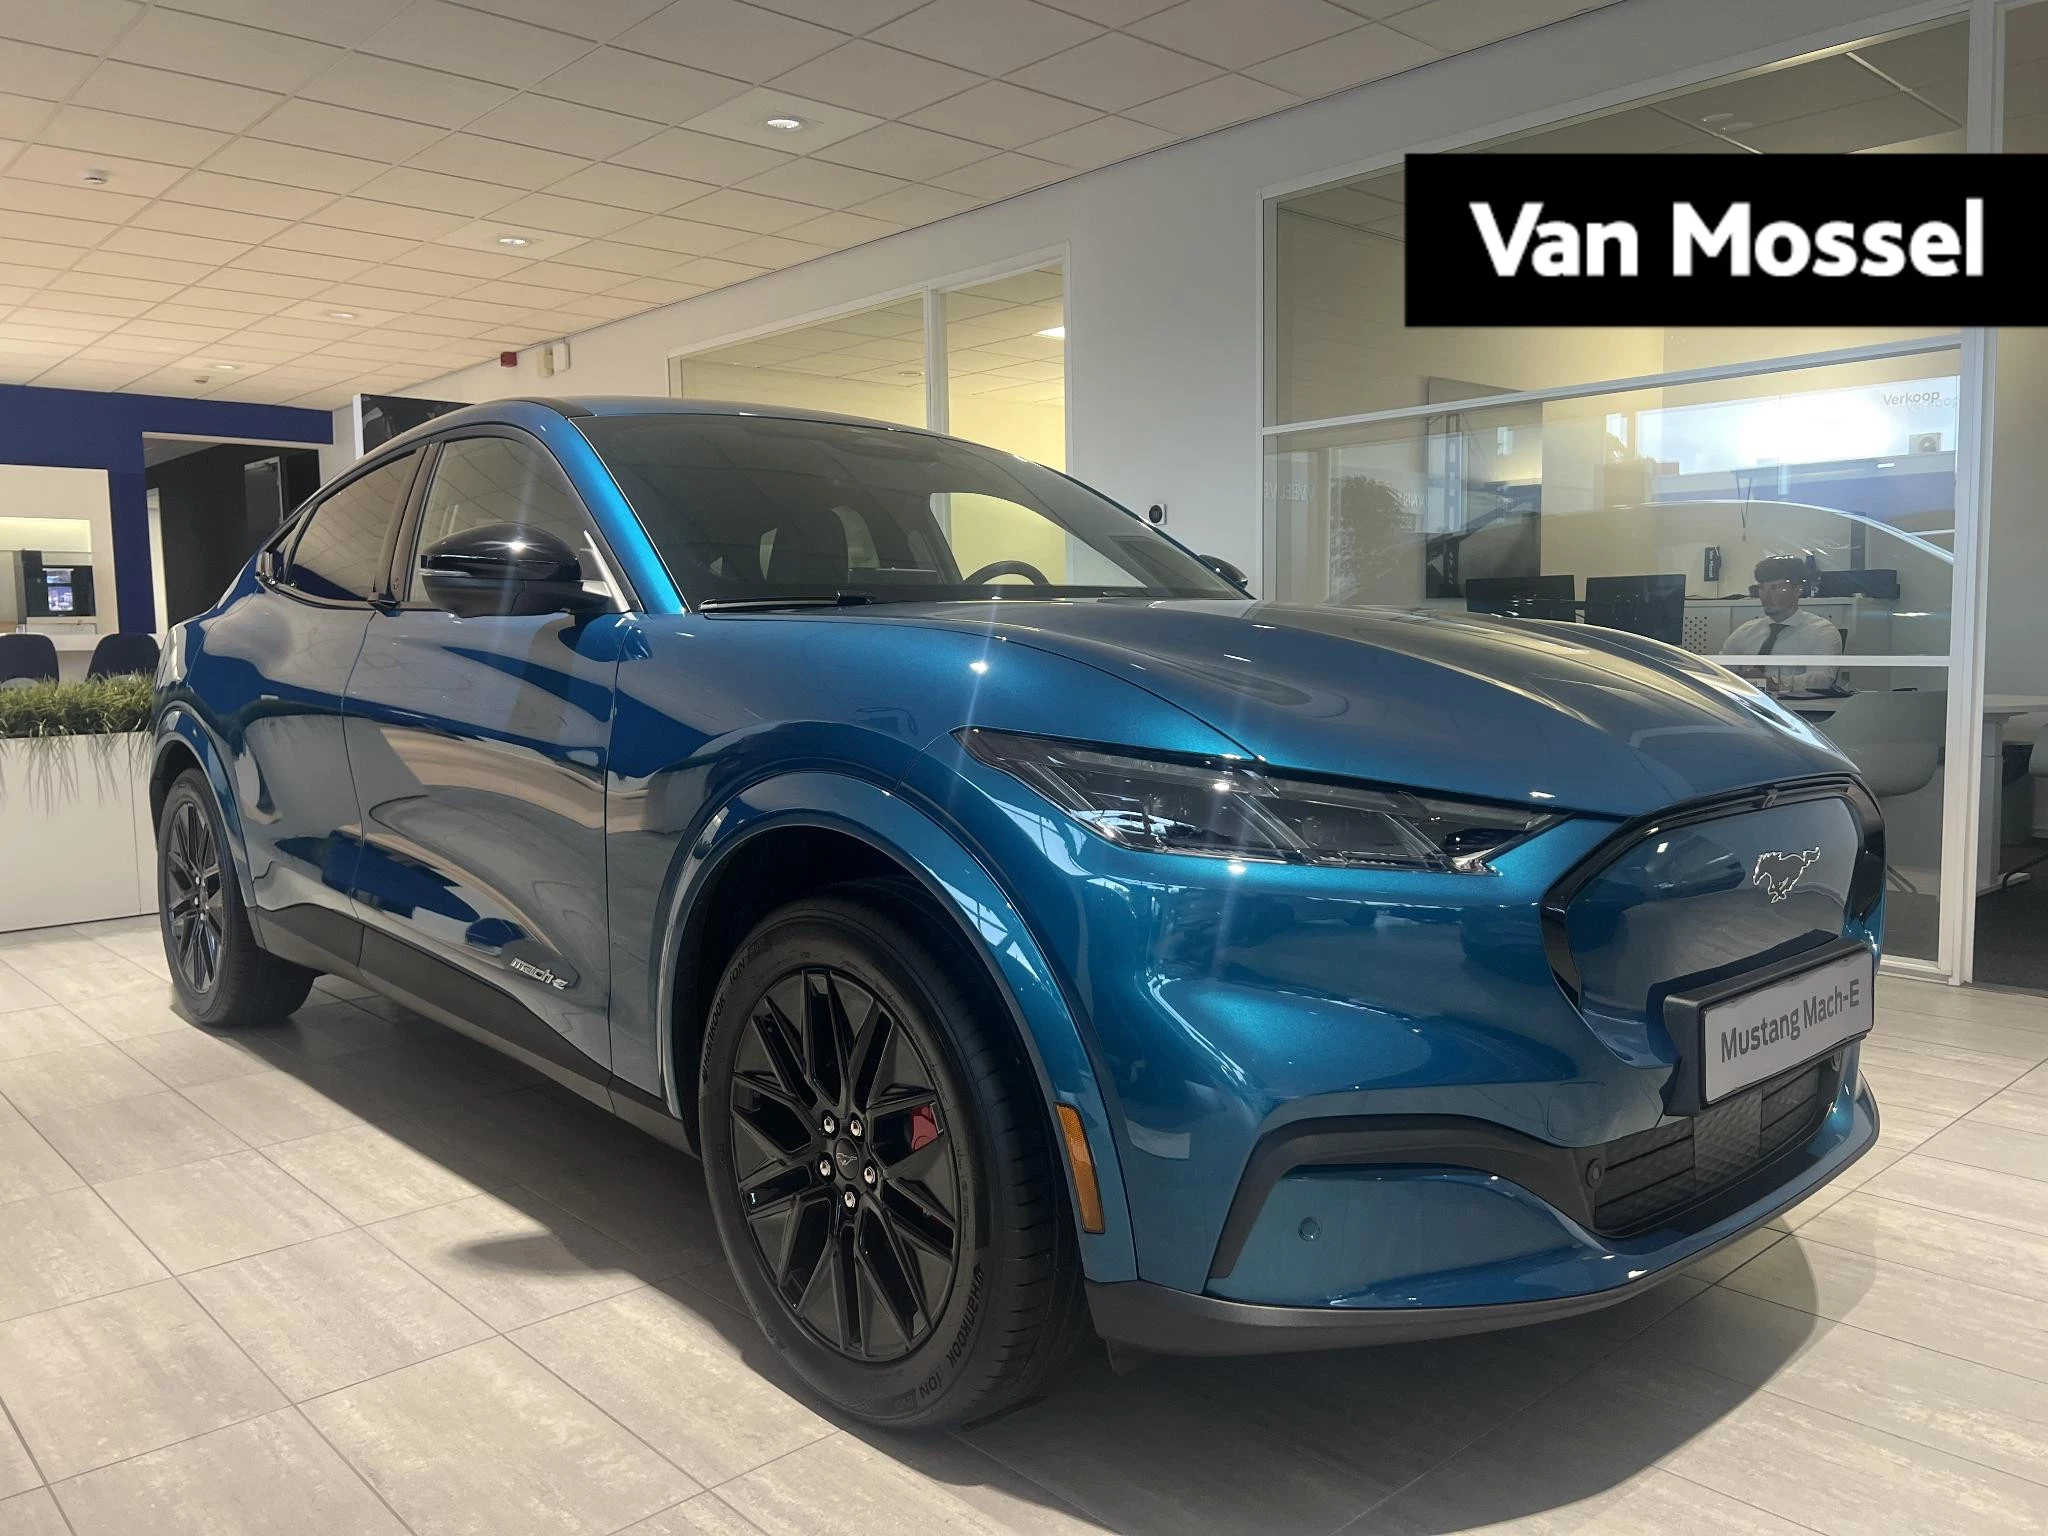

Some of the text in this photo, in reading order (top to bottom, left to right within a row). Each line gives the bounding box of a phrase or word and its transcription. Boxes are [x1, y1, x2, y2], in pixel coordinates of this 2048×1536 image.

[1883, 391, 1940, 406] Verkoop
[1721, 979, 1860, 1063] Mustang Mach-E
